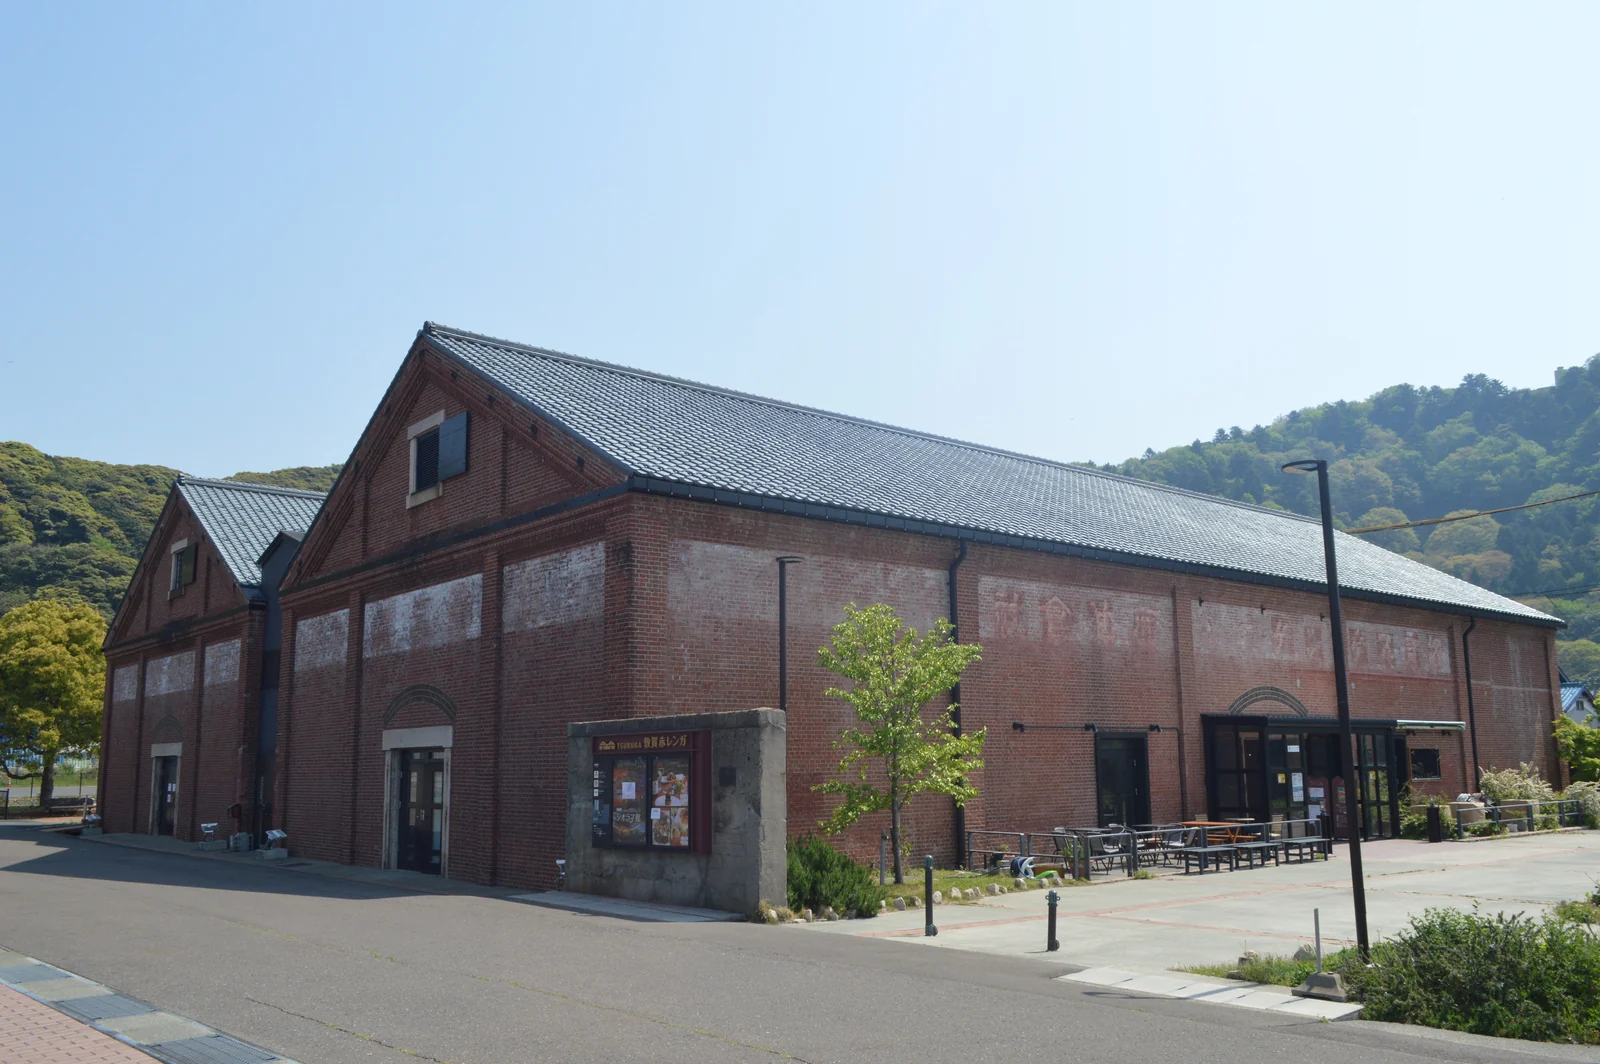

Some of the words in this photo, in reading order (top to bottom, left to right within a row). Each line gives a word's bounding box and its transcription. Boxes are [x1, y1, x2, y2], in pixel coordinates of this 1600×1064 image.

[616, 741, 642, 750] TSURUGA
[643, 735, 687, 748] 敦賀赤レンガ
